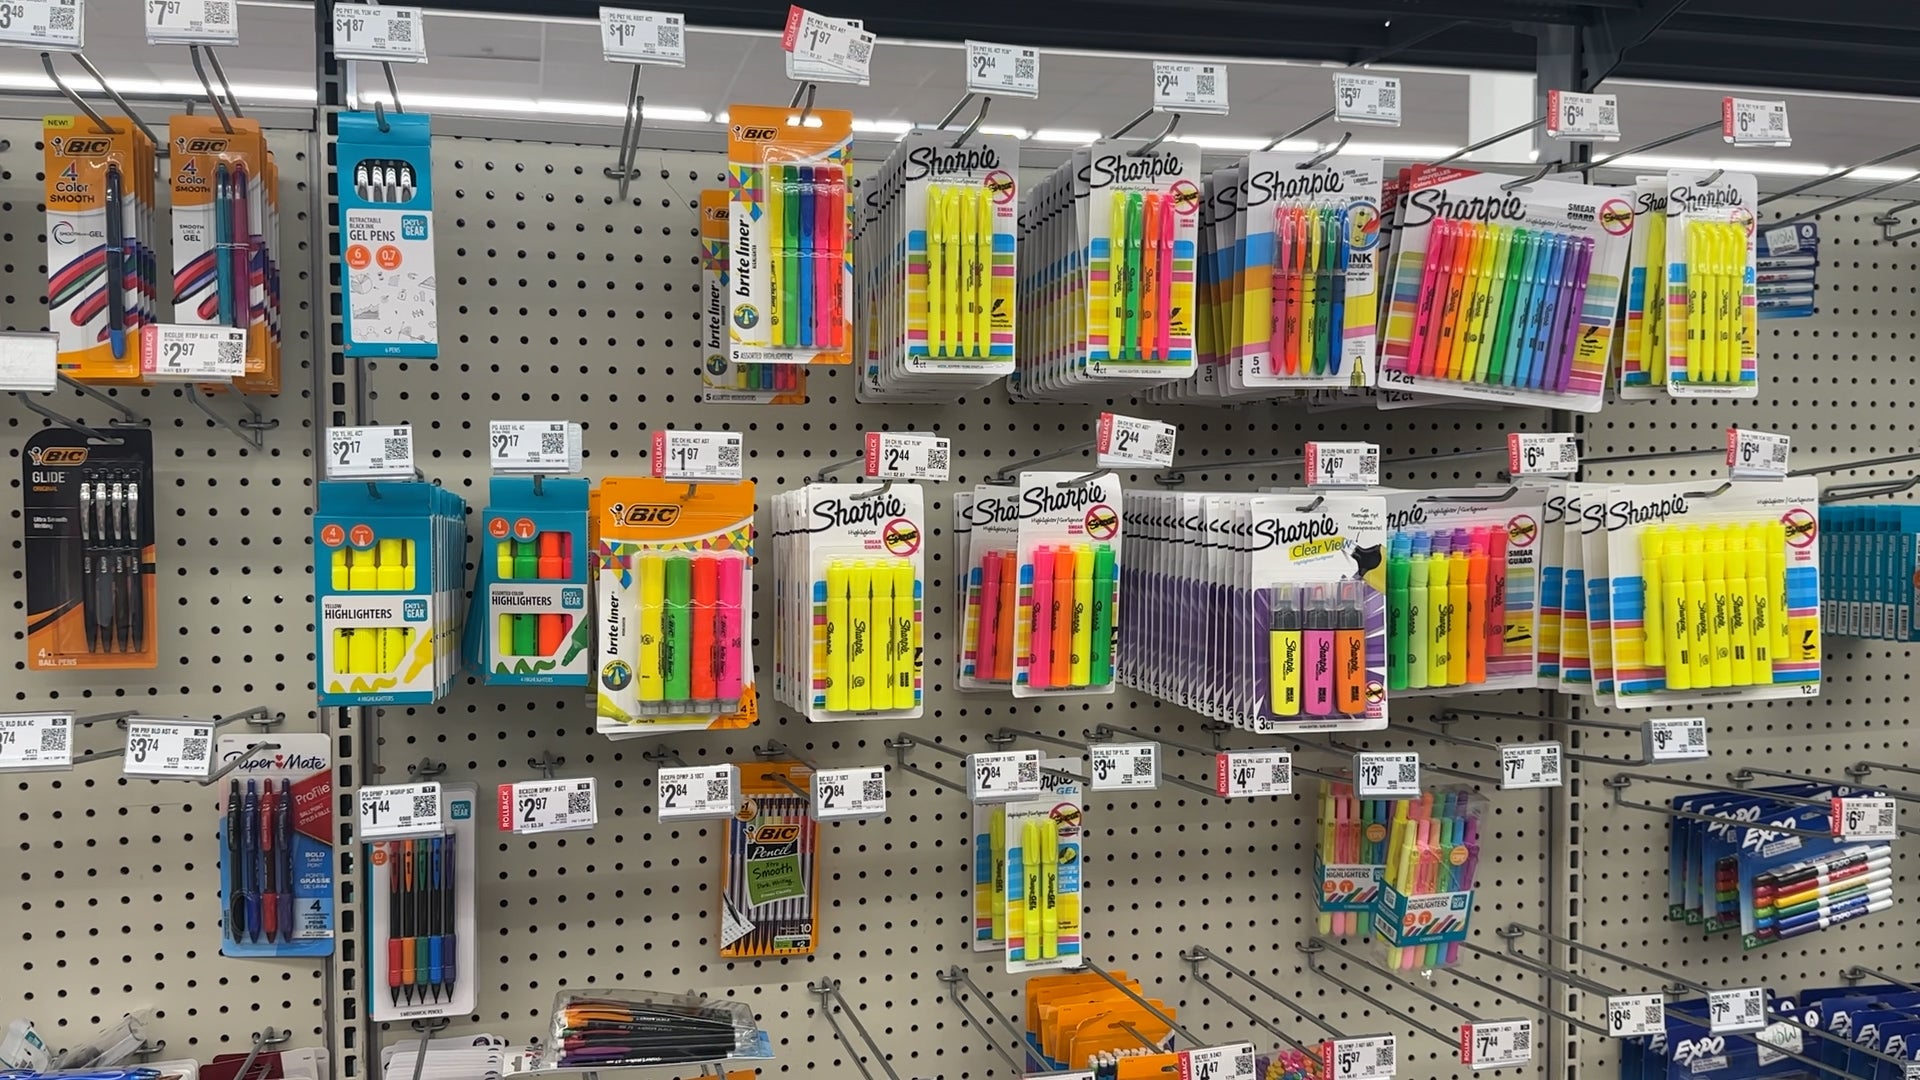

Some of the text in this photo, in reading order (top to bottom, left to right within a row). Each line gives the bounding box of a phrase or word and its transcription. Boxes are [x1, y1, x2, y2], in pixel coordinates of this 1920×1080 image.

[48, 119, 68, 127] NEW!
[906, 144, 1000, 182] Sharpie
[1090, 152, 1183, 189] Sharpie
[177, 175, 206, 185] Color
[56, 181, 89, 192] Color
[175, 185, 211, 194] SMOOTH
[1248, 167, 1344, 206] Sharpie
[50, 194, 95, 204] SMOOTH
[1404, 189, 1527, 228] Sharpie
[1568, 204, 1596, 213] SMEAR
[1567, 212, 1595, 222] GUARD
[349, 230, 395, 241] GEL PENS
[405, 227, 424, 236] GEAR
[183, 234, 201, 242] GEL
[355, 249, 361, 259] 6
[382, 250, 396, 261] 0.7
[1253, 356, 1259, 365] 5
[1251, 366, 1260, 375] ct
[32, 471, 66, 483] GLIDE
[1019, 482, 1106, 519] Sharpie
[808, 495, 906, 533] Sharpie
[1607, 494, 1688, 531] Sharpie
[1252, 513, 1338, 550] Sharpie
[1293, 538, 1352, 558] Clear View
[1509, 557, 1533, 565] GUARD
[492, 596, 552, 606] HIGHLIGHTERS
[325, 609, 392, 620] HIGHLIGHTERS
[407, 610, 424, 618] GEAR
[607, 596, 619, 655] brite liner
[38, 648, 46, 658] 4
[740, 705, 747, 713] 4
[1259, 717, 1274, 730] 3CT
[283, 753, 326, 770] Mate
[295, 783, 331, 806] Profile
[1056, 787, 1079, 795] GEL
[751, 843, 792, 860] Pencil
[752, 864, 793, 880] Smooth
[310, 900, 322, 912] 4
[1408, 901, 1448, 911] HIGHLIGHTERS
[799, 923, 811, 933] 10
[1706, 919, 1717, 930] 12
[1745, 936, 1756, 947] 12
[1673, 1036, 1725, 1067] EXPO
